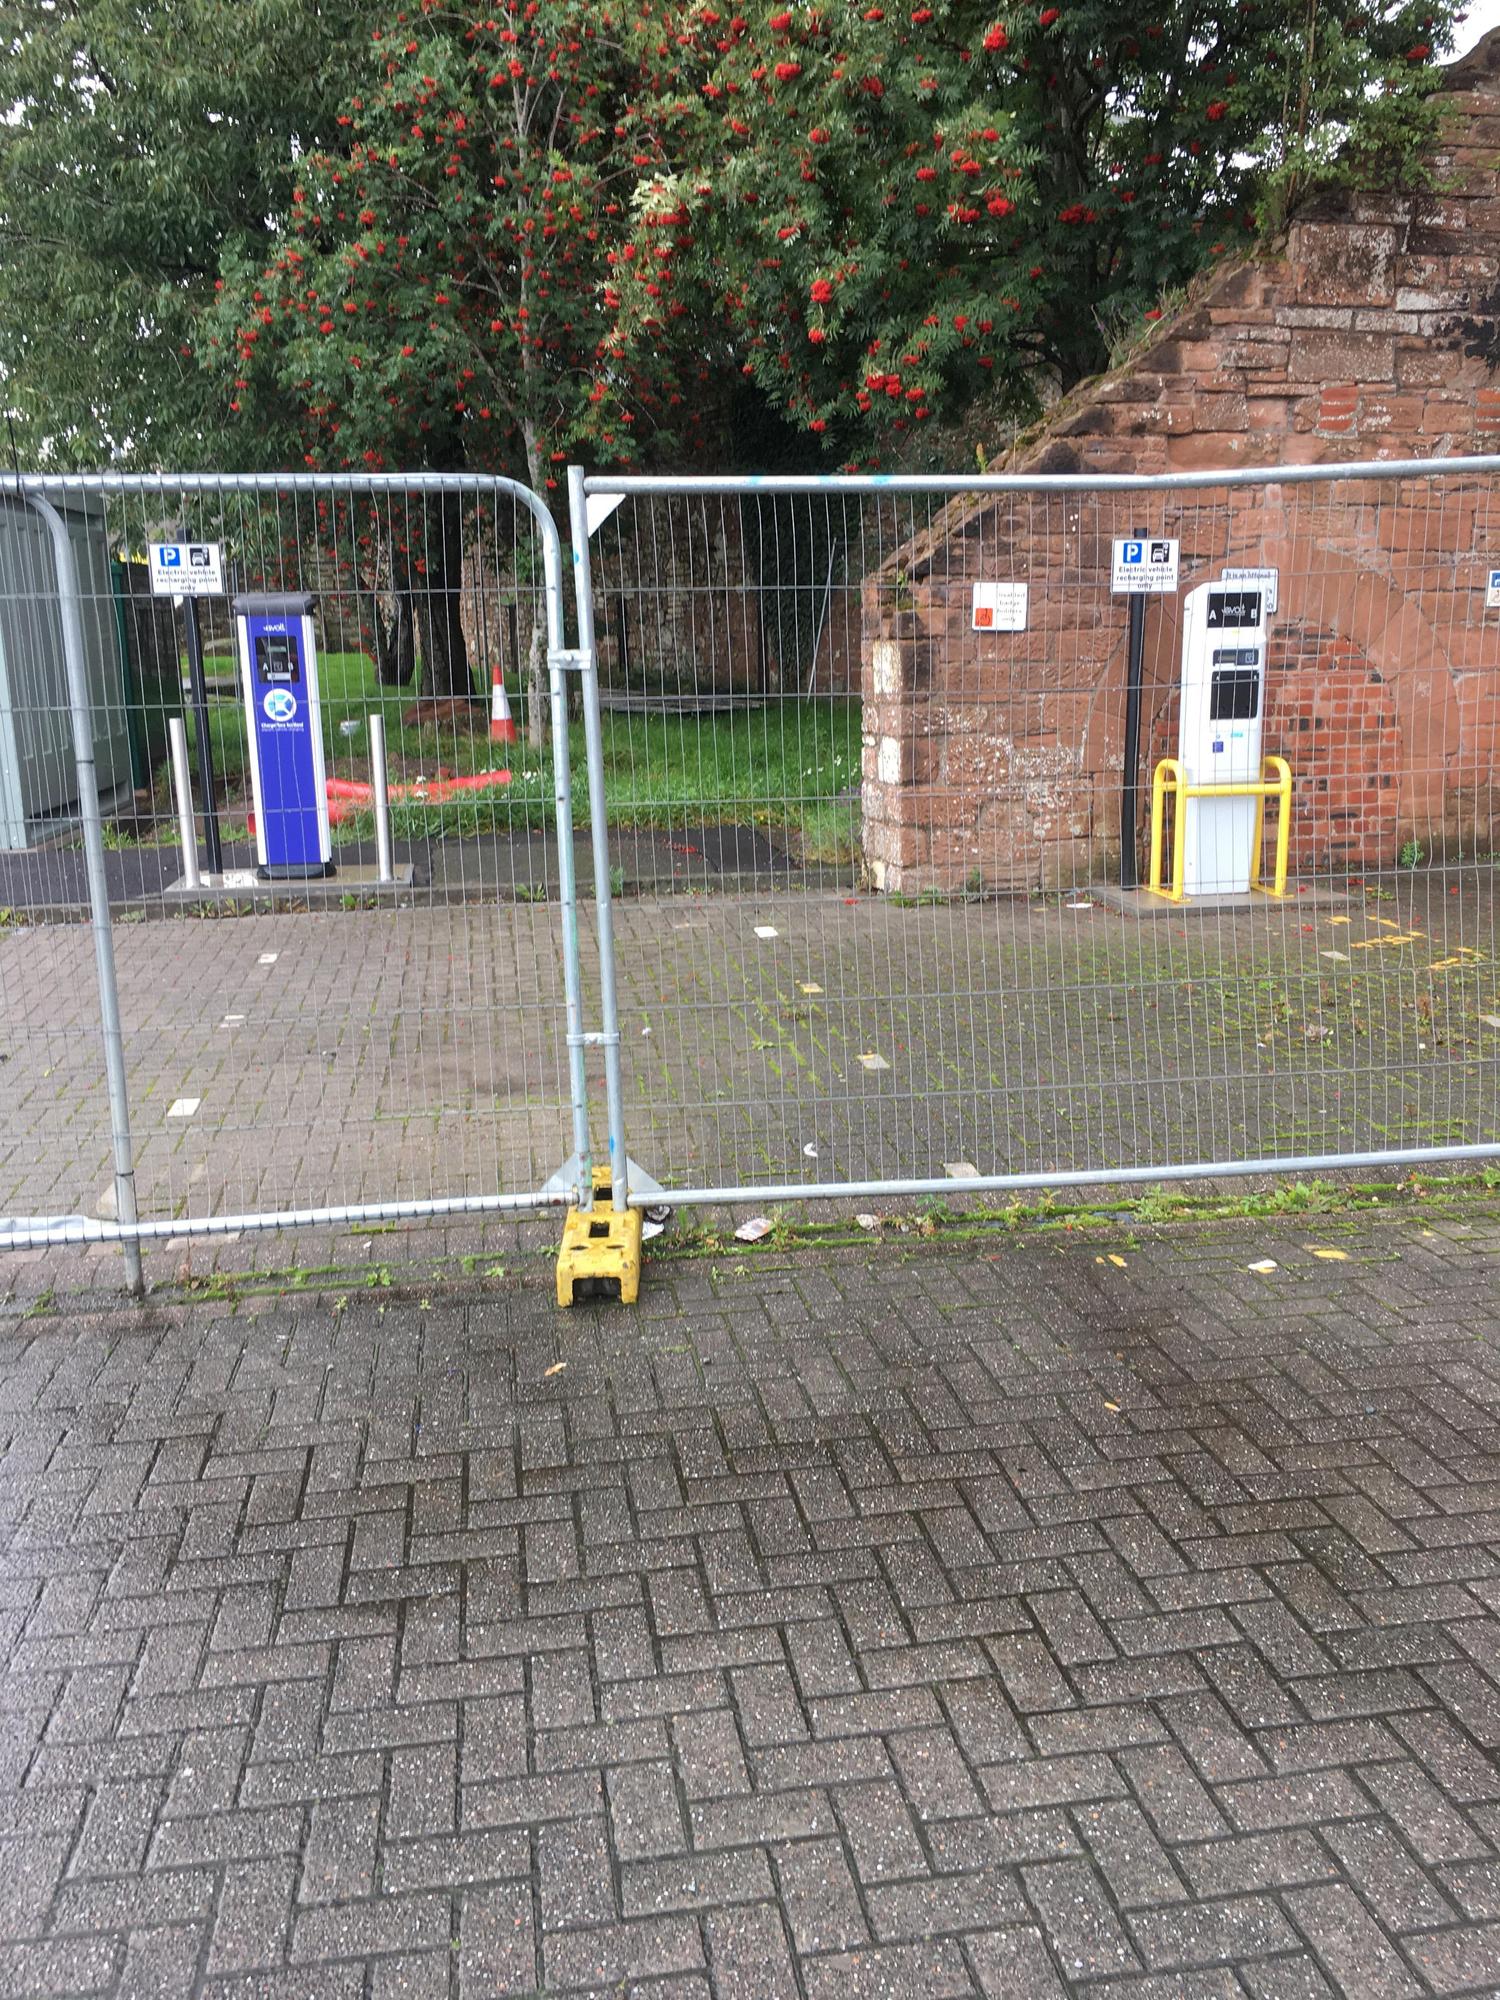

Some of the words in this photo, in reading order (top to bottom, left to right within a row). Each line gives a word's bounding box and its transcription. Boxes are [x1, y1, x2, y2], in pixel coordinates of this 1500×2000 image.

[1118, 565, 1146, 573] Electric
[1148, 565, 1173, 573] vehicle
[1116, 574, 1154, 582] recharging
[1155, 574, 1174, 582] point
[1137, 582, 1153, 590] only
[1208, 608, 1217, 620] A
[1250, 608, 1258, 619] B
[262, 662, 269, 671] A
